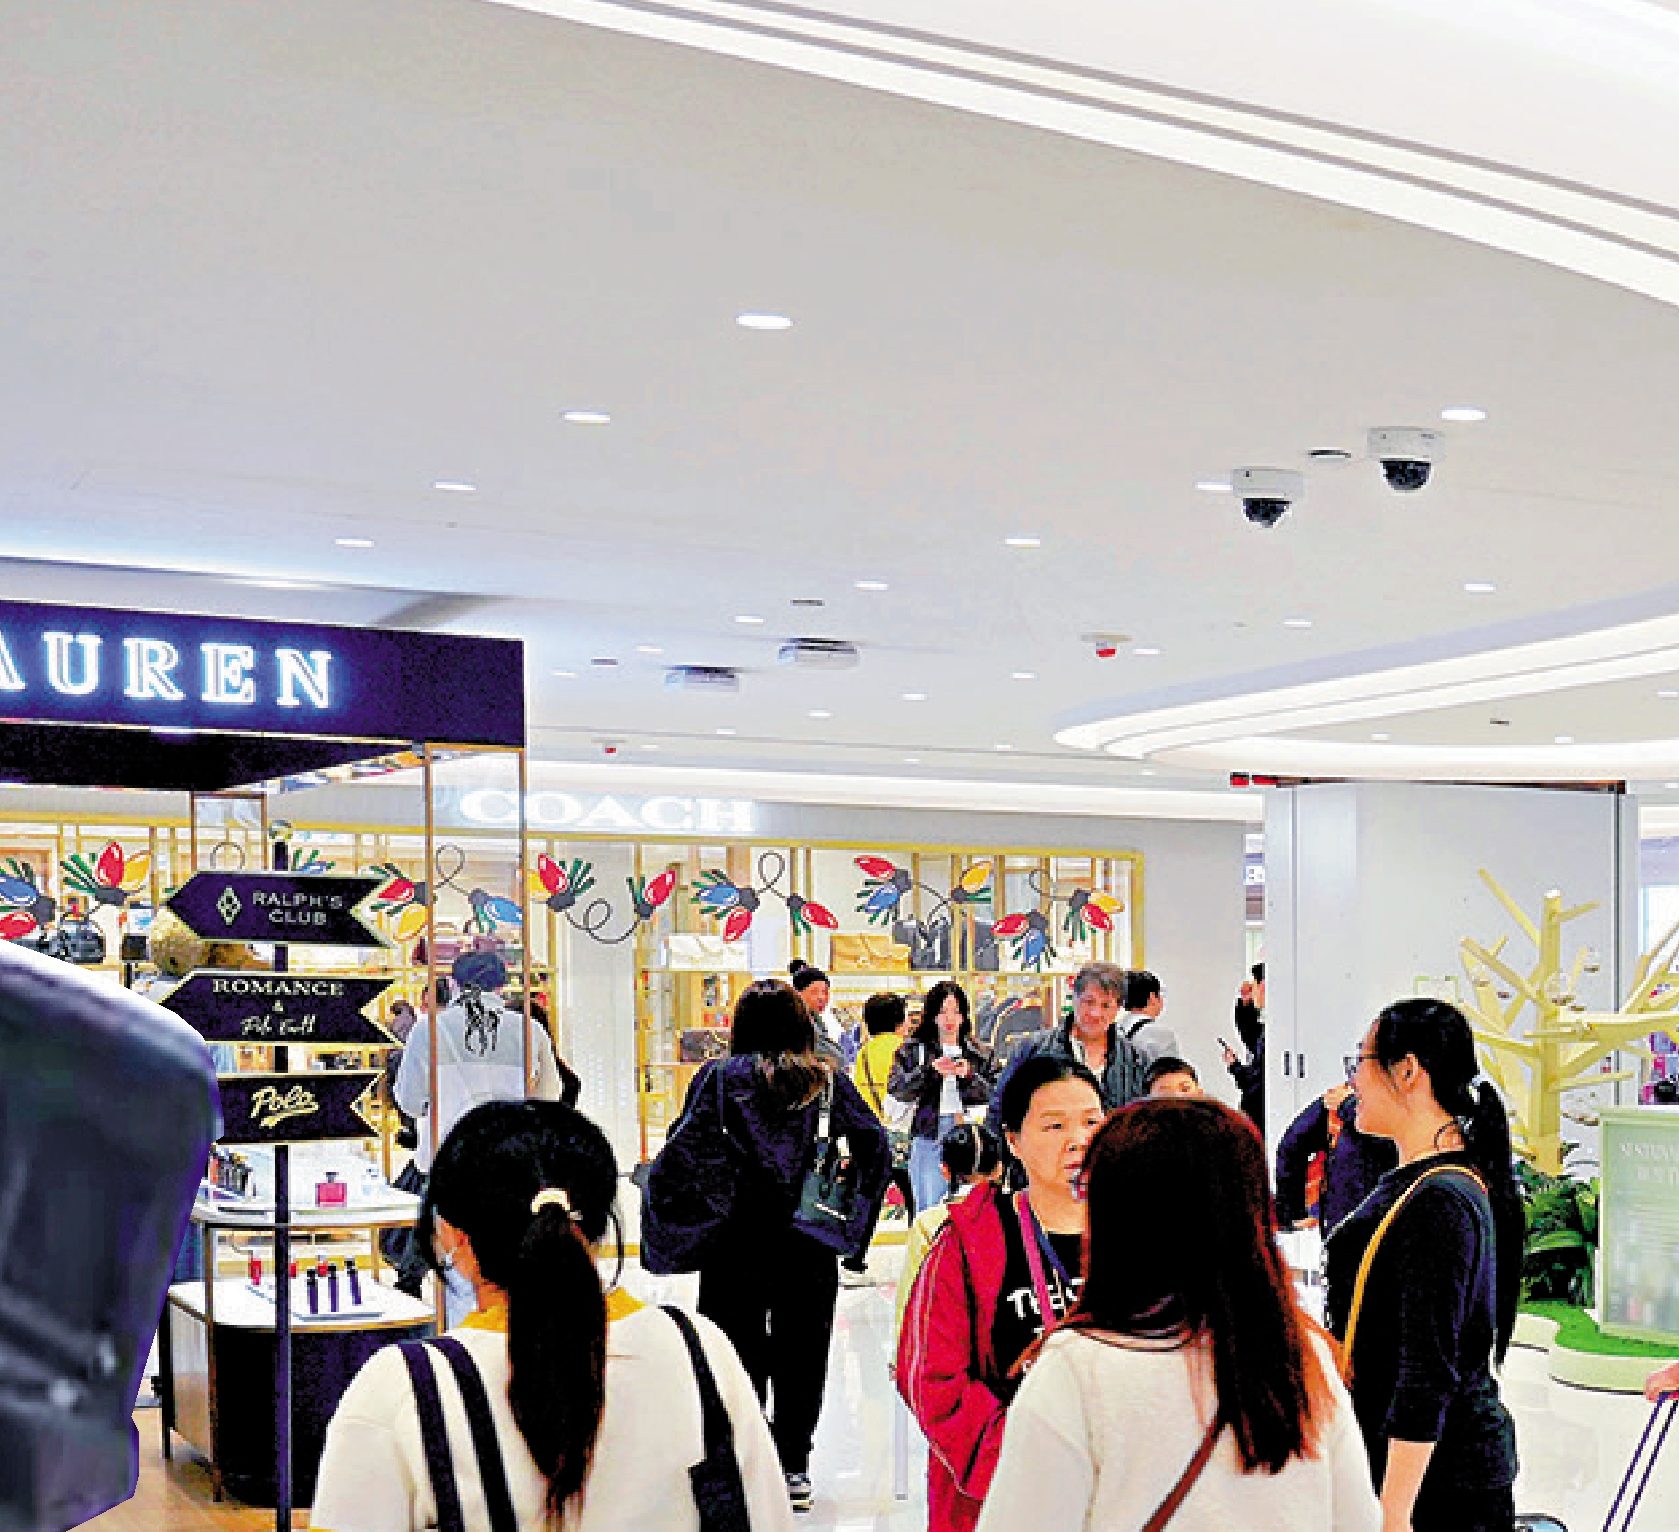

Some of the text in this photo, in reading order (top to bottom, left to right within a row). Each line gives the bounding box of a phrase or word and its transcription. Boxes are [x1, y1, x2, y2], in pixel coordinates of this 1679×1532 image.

[459, 787, 758, 834] COACH
[252, 892, 343, 909] RALPH'S
[268, 909, 328, 926] CLUB
[212, 978, 344, 996] ROMANCE
[250, 1084, 320, 1127] Polo
